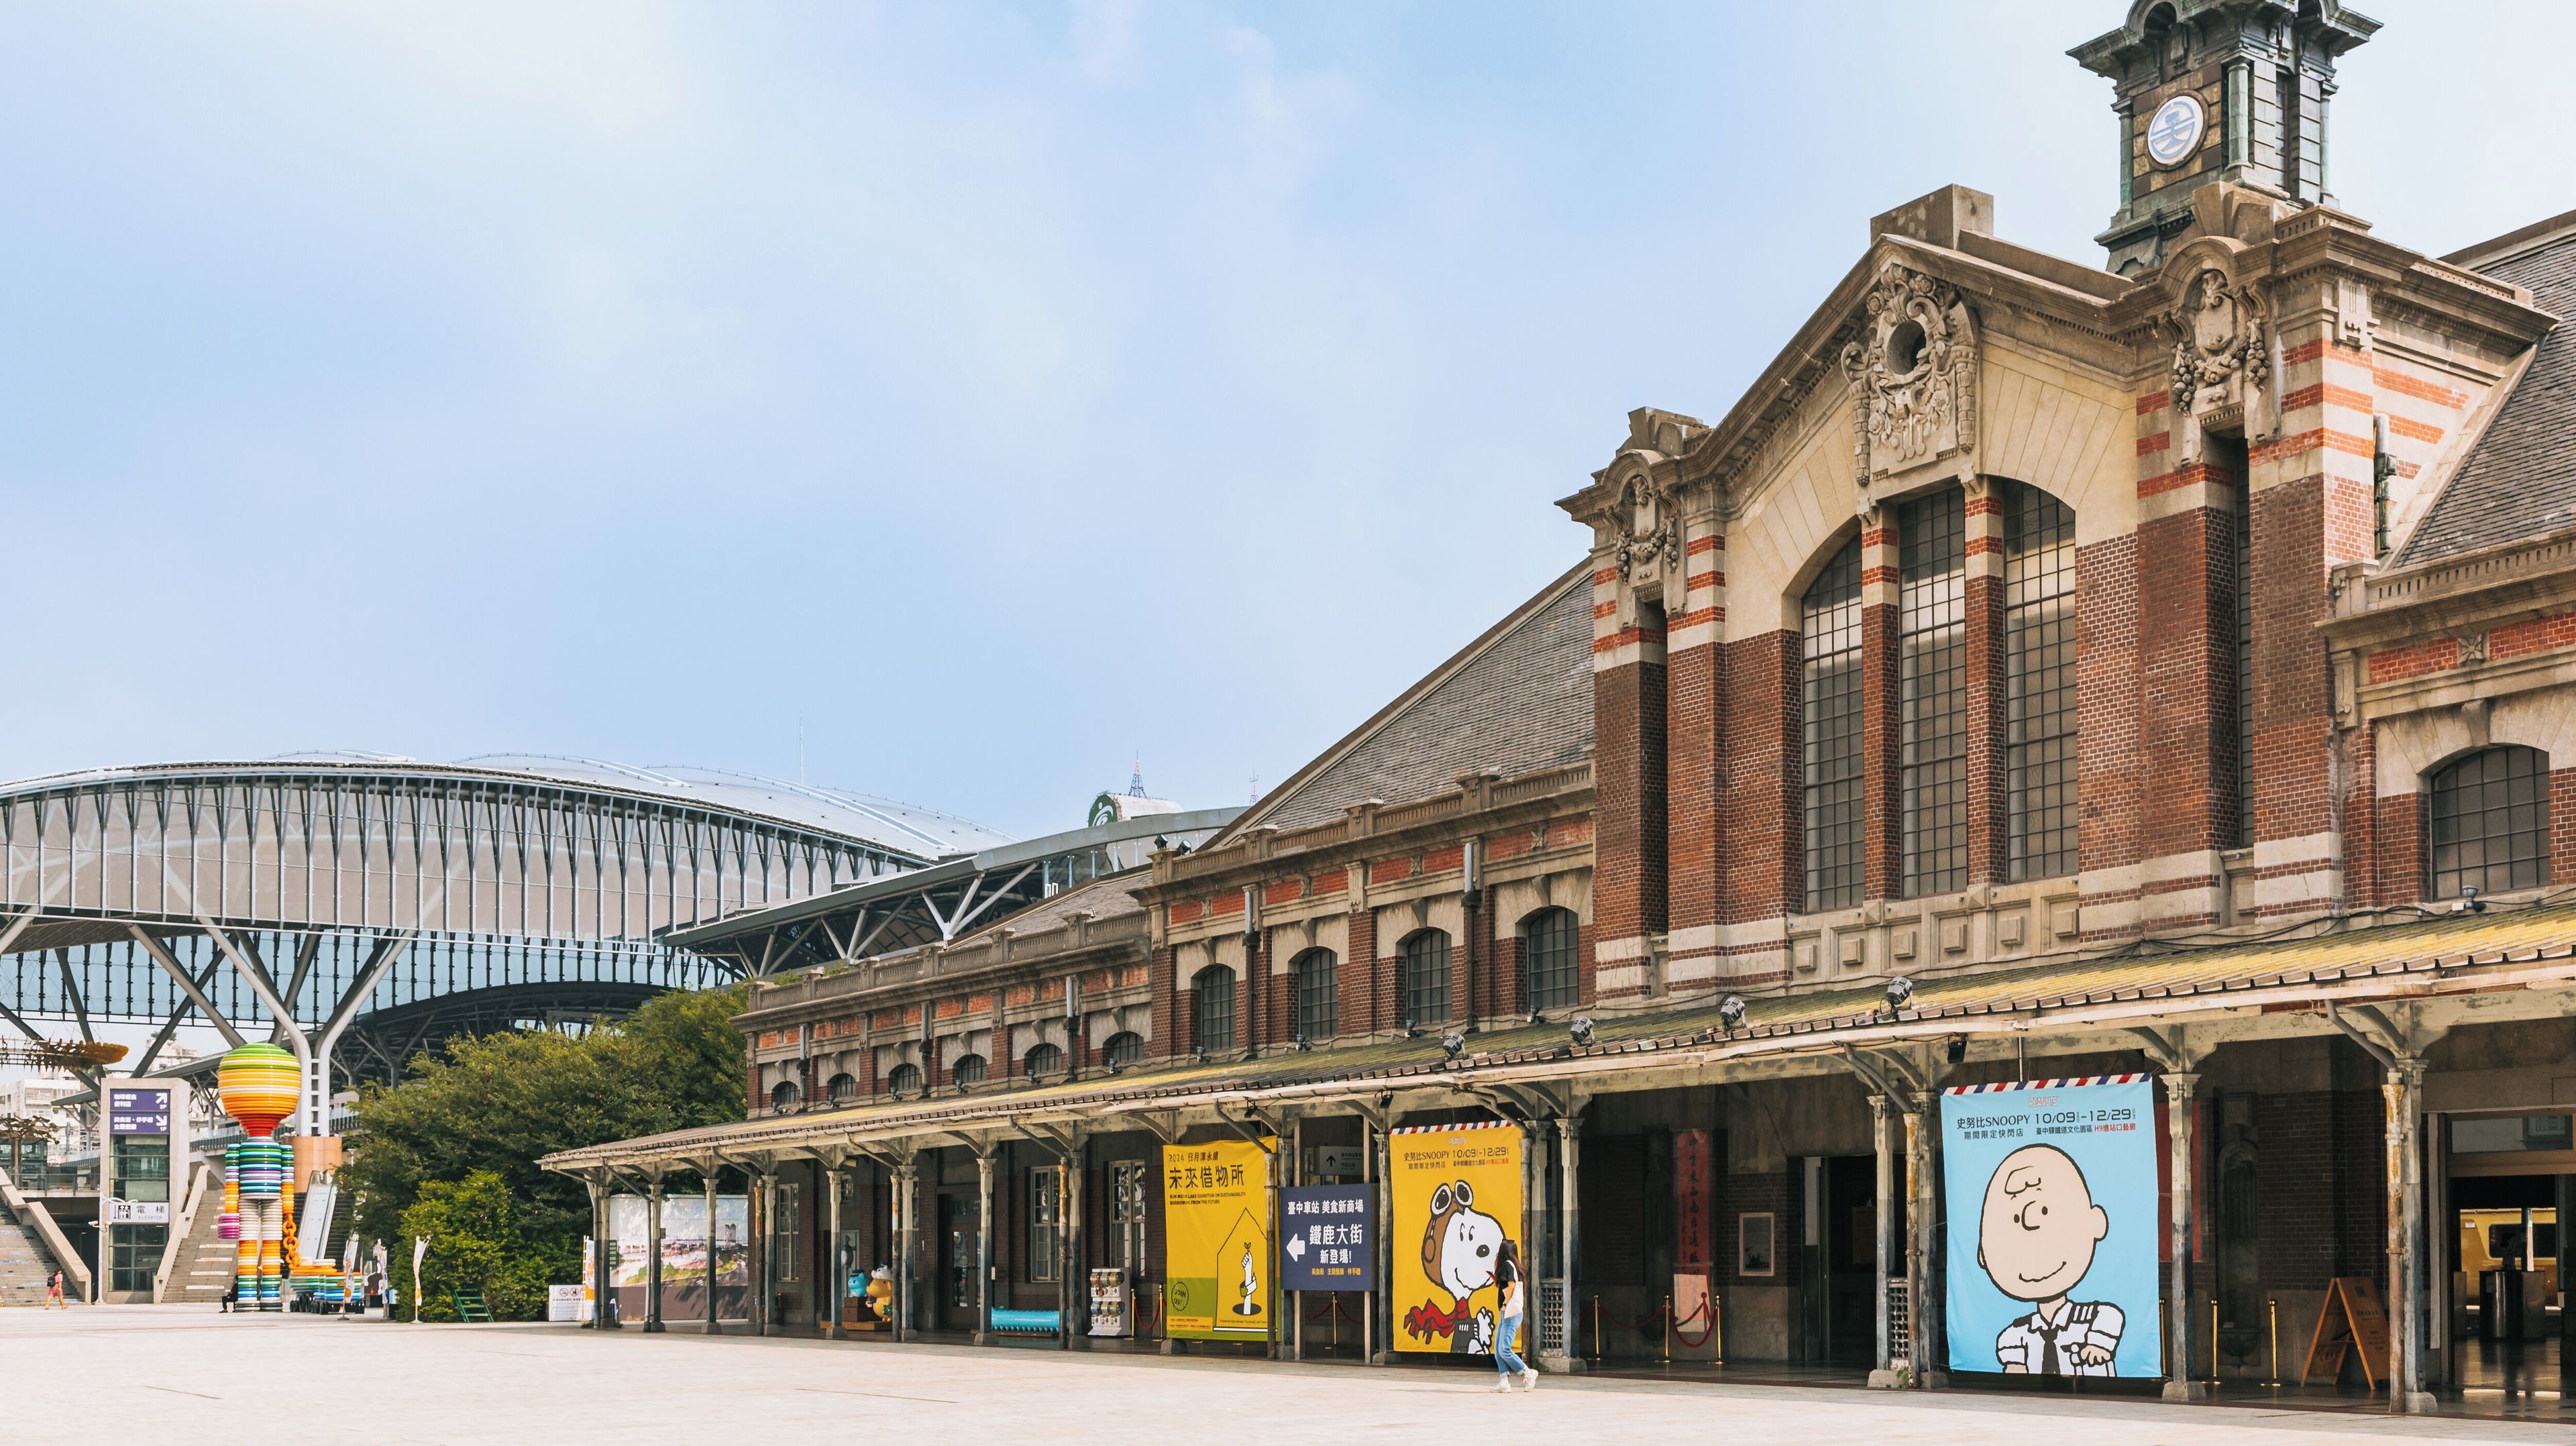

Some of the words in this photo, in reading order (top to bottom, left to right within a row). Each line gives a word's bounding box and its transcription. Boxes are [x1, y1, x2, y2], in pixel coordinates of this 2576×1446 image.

[2029, 1097, 2058, 1107] PEANUTS
[1957, 1115, 2031, 1129] 史努比SNOOPY
[2035, 1111, 2075, 1124] 10/09
[1964, 1128, 2023, 1140] 期間限定快閃店
[1169, 1154, 1184, 1162] 2024
[1188, 1151, 1218, 1162] 日月潭永續
[1404, 1150, 1450, 1162] 史努比SNOOPY
[1453, 1149, 1476, 1158] 10/09
[1409, 1161, 1446, 1170] 期間限定快閃店
[1169, 1164, 1244, 1189] 未來借物所
[1288, 1201, 1320, 1215] 臺中車站
[1322, 1199, 1364, 1214] 美食新商場
[1309, 1223, 1362, 1245] 鐵鹿大街
[1320, 1248, 1352, 1264] 新登場!
[1174, 1289, 1186, 1298] JOIN
